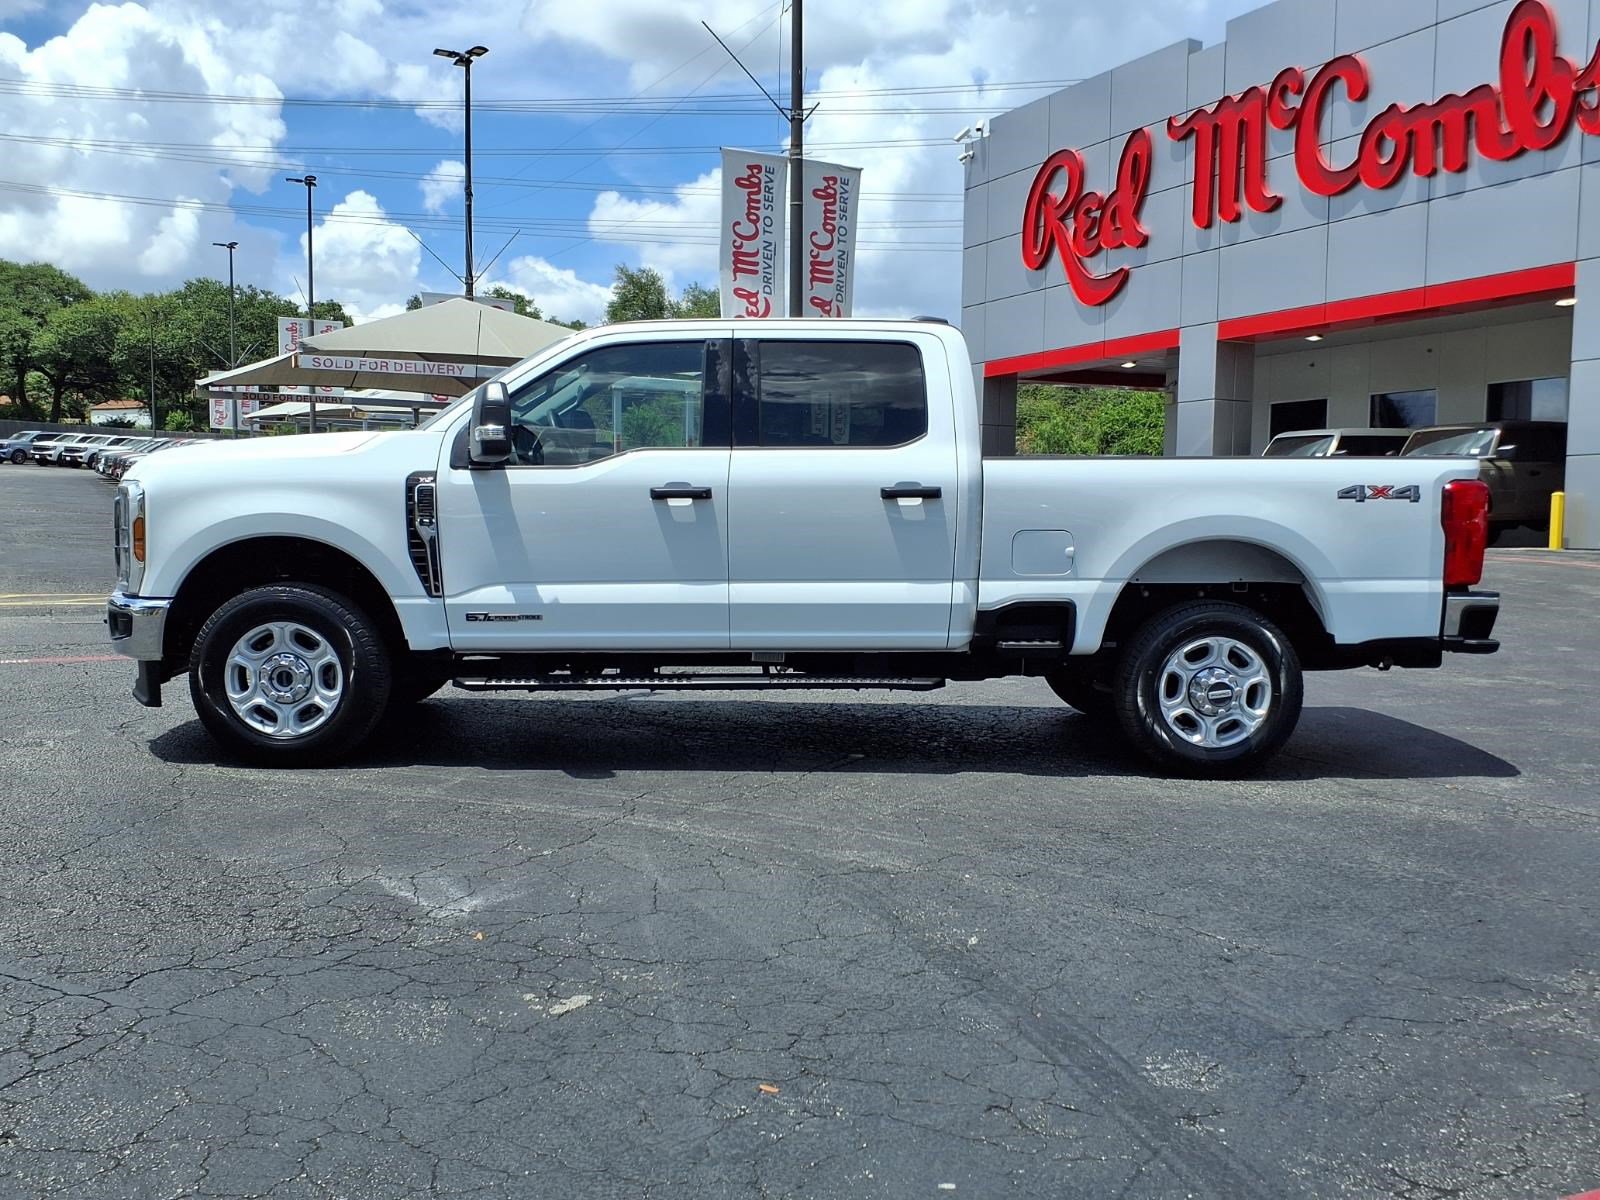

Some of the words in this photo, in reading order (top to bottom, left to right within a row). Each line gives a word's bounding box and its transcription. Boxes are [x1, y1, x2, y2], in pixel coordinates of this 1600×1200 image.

[764, 165, 776, 212] SERVE
[838, 176, 850, 223] SERVE
[732, 164, 763, 282] McCombs
[763, 215, 774, 237] TO
[809, 175, 838, 291] McCombs
[837, 227, 848, 245] TO
[1021, 127, 1153, 308] Red
[762, 241, 773, 296] DRIVEN
[835, 250, 847, 304] DRIVEN
[733, 287, 771, 318] ed
[284, 322, 298, 354] Combs
[312, 357, 354, 369] SOLD
[359, 360, 389, 371] FOR
[394, 361, 465, 376] DELIVERY
[242, 393, 270, 401] SOLD
[272, 393, 293, 402] FOR
[295, 394, 344, 404] DELIVERY
